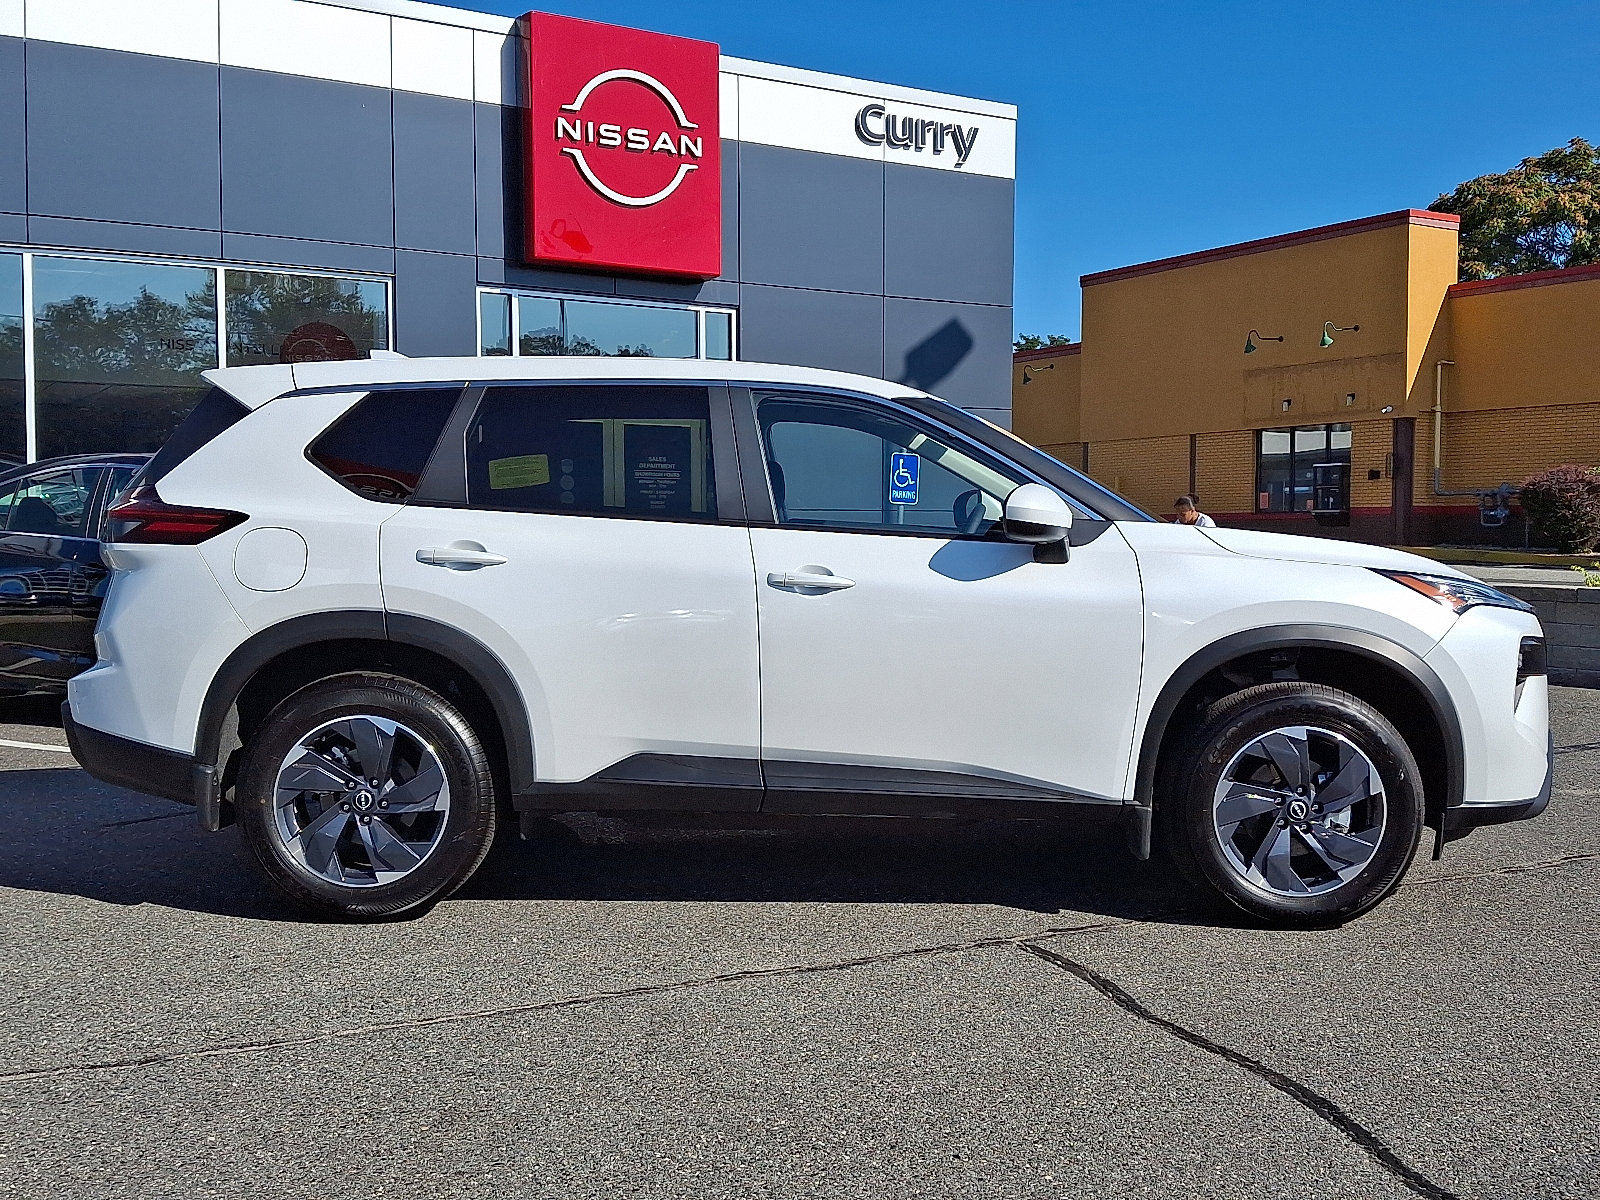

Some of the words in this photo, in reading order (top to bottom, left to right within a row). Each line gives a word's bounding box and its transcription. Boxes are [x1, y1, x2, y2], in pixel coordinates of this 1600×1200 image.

[555, 116, 703, 159] NISSAN
[855, 103, 980, 167] Curry
[892, 490, 915, 500] PARKING
